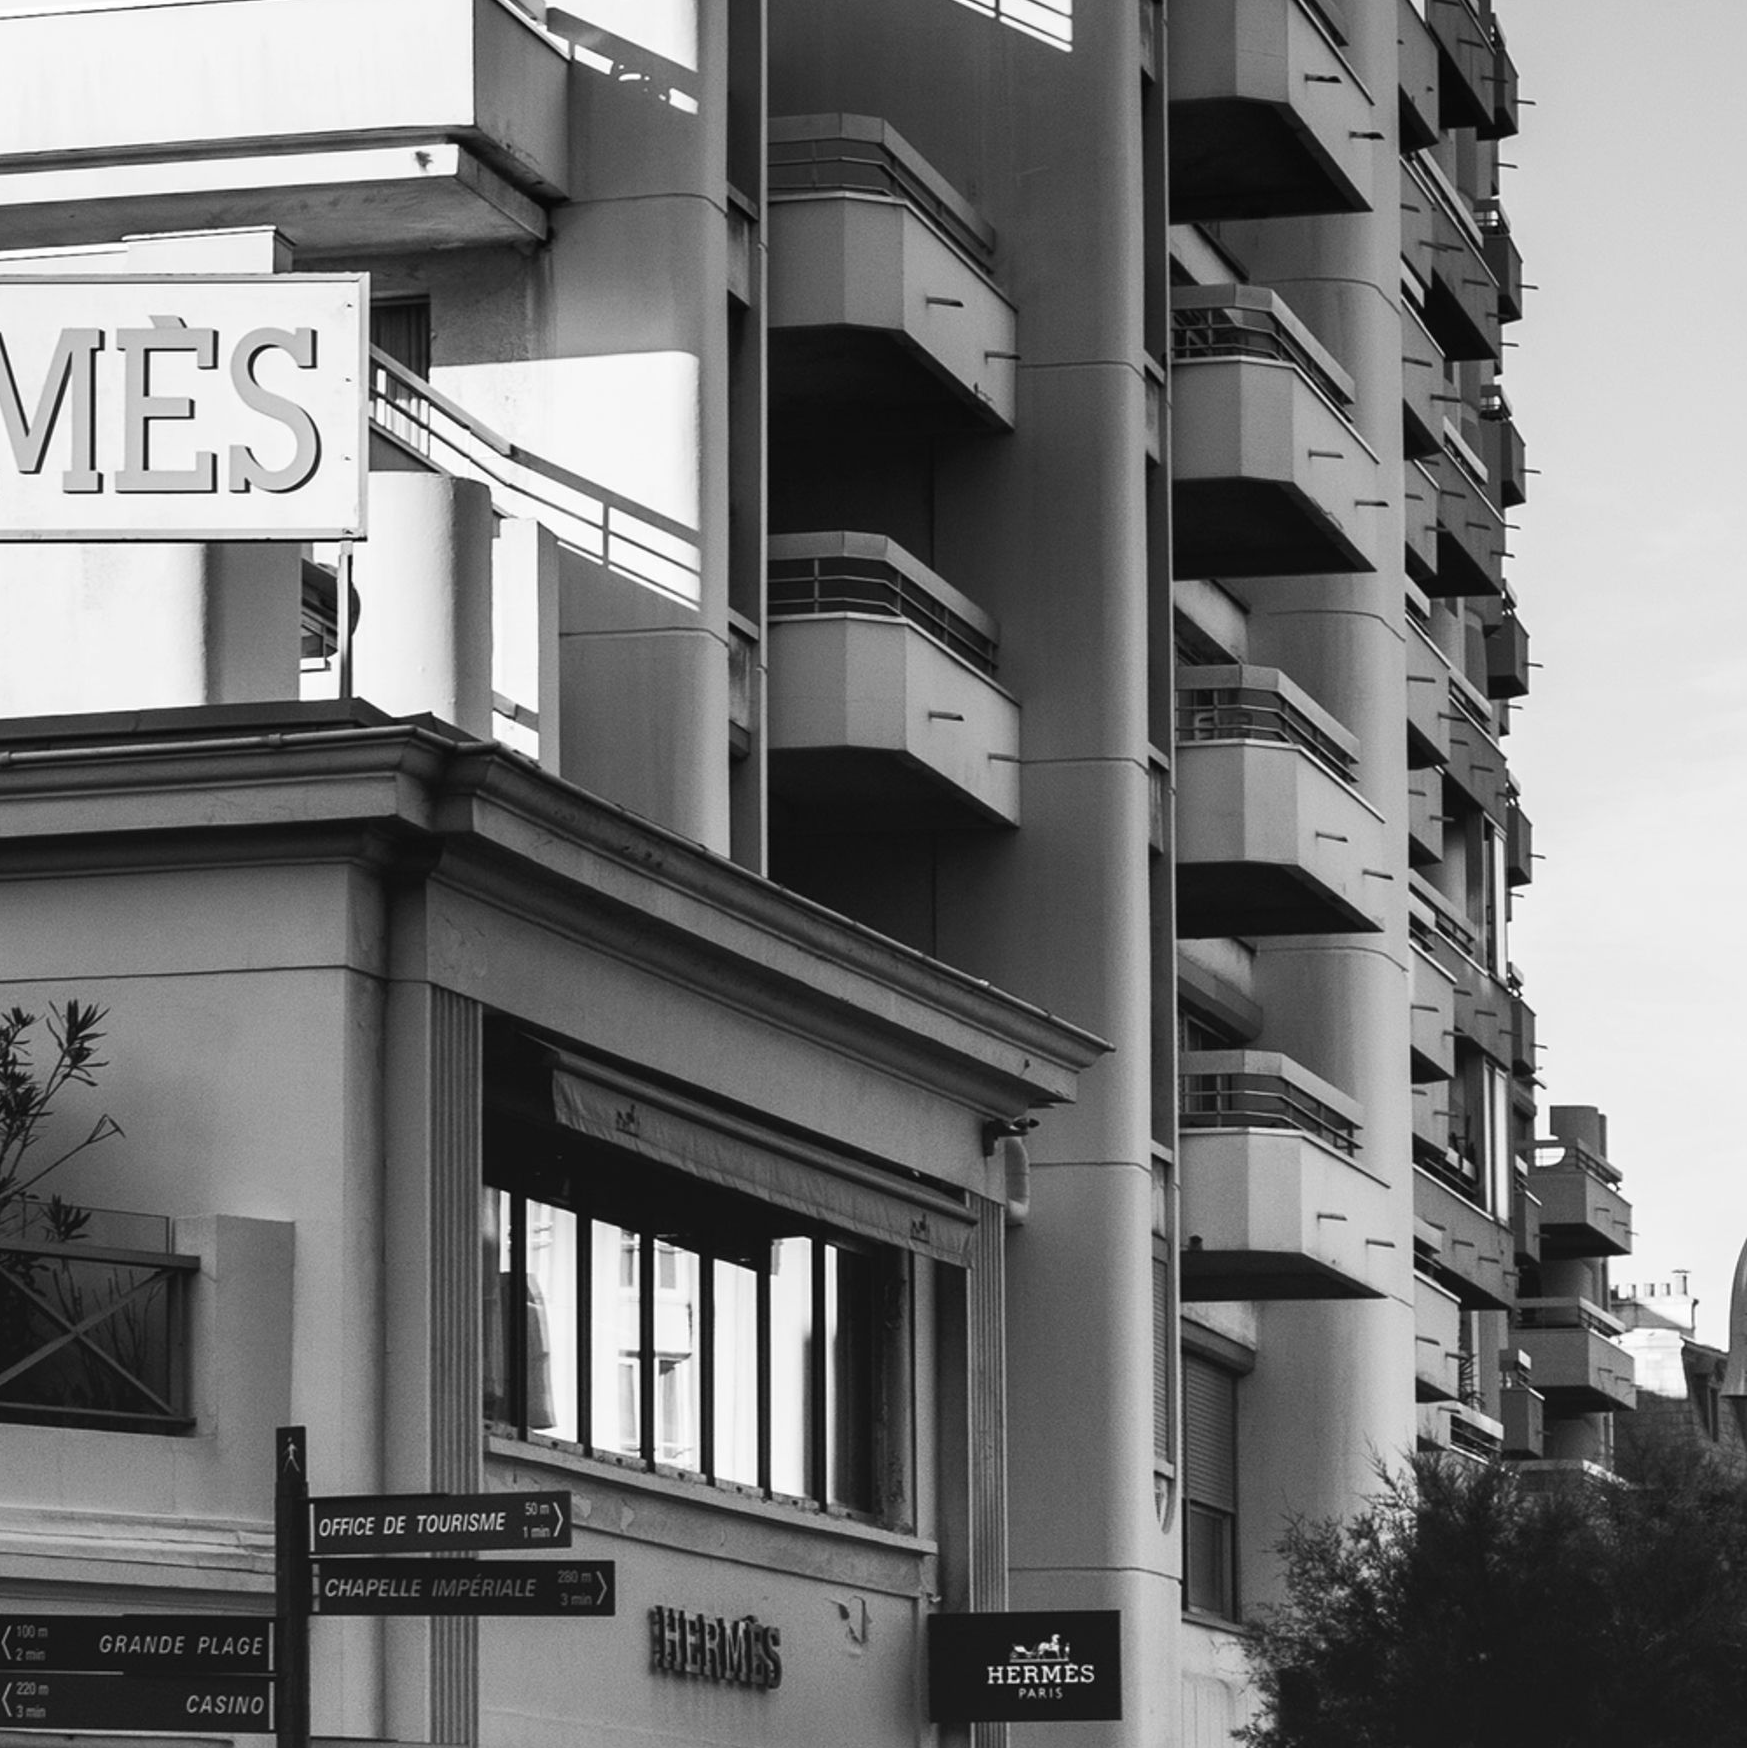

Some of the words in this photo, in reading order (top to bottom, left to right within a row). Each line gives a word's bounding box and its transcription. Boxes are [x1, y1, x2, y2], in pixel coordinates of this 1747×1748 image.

[524, 1503, 537, 1516] 50
[539, 1505, 550, 1515] m
[318, 1517, 375, 1537] OFFICE
[383, 1515, 406, 1535] DE
[416, 1512, 506, 1533] TOURISME
[523, 1527, 529, 1538] 1
[530, 1526, 550, 1538] min
[557, 1570, 578, 1583] 280
[581, 1573, 592, 1583] m
[324, 1578, 422, 1597] CHAPELLE
[431, 1573, 536, 1597] IMPÉRIALE
[560, 1594, 568, 1606] 3
[571, 1593, 592, 1606] min
[16, 1625, 36, 1638] 100
[38, 1627, 48, 1637] m
[99, 1635, 185, 1654] GRANDE
[197, 1637, 263, 1655] PLAGE
[648, 1605, 783, 1691] HERMÈS
[15, 1649, 22, 1661] 2
[25, 1649, 46, 1661] min
[987, 1662, 1095, 1684] HERMÈS
[16, 1682, 36, 1695] 220
[38, 1685, 49, 1695] m
[1018, 1687, 1063, 1699] PARIS
[186, 1695, 265, 1715] CASINO
[16, 1706, 23, 1718] 3
[26, 1706, 46, 1718] min
